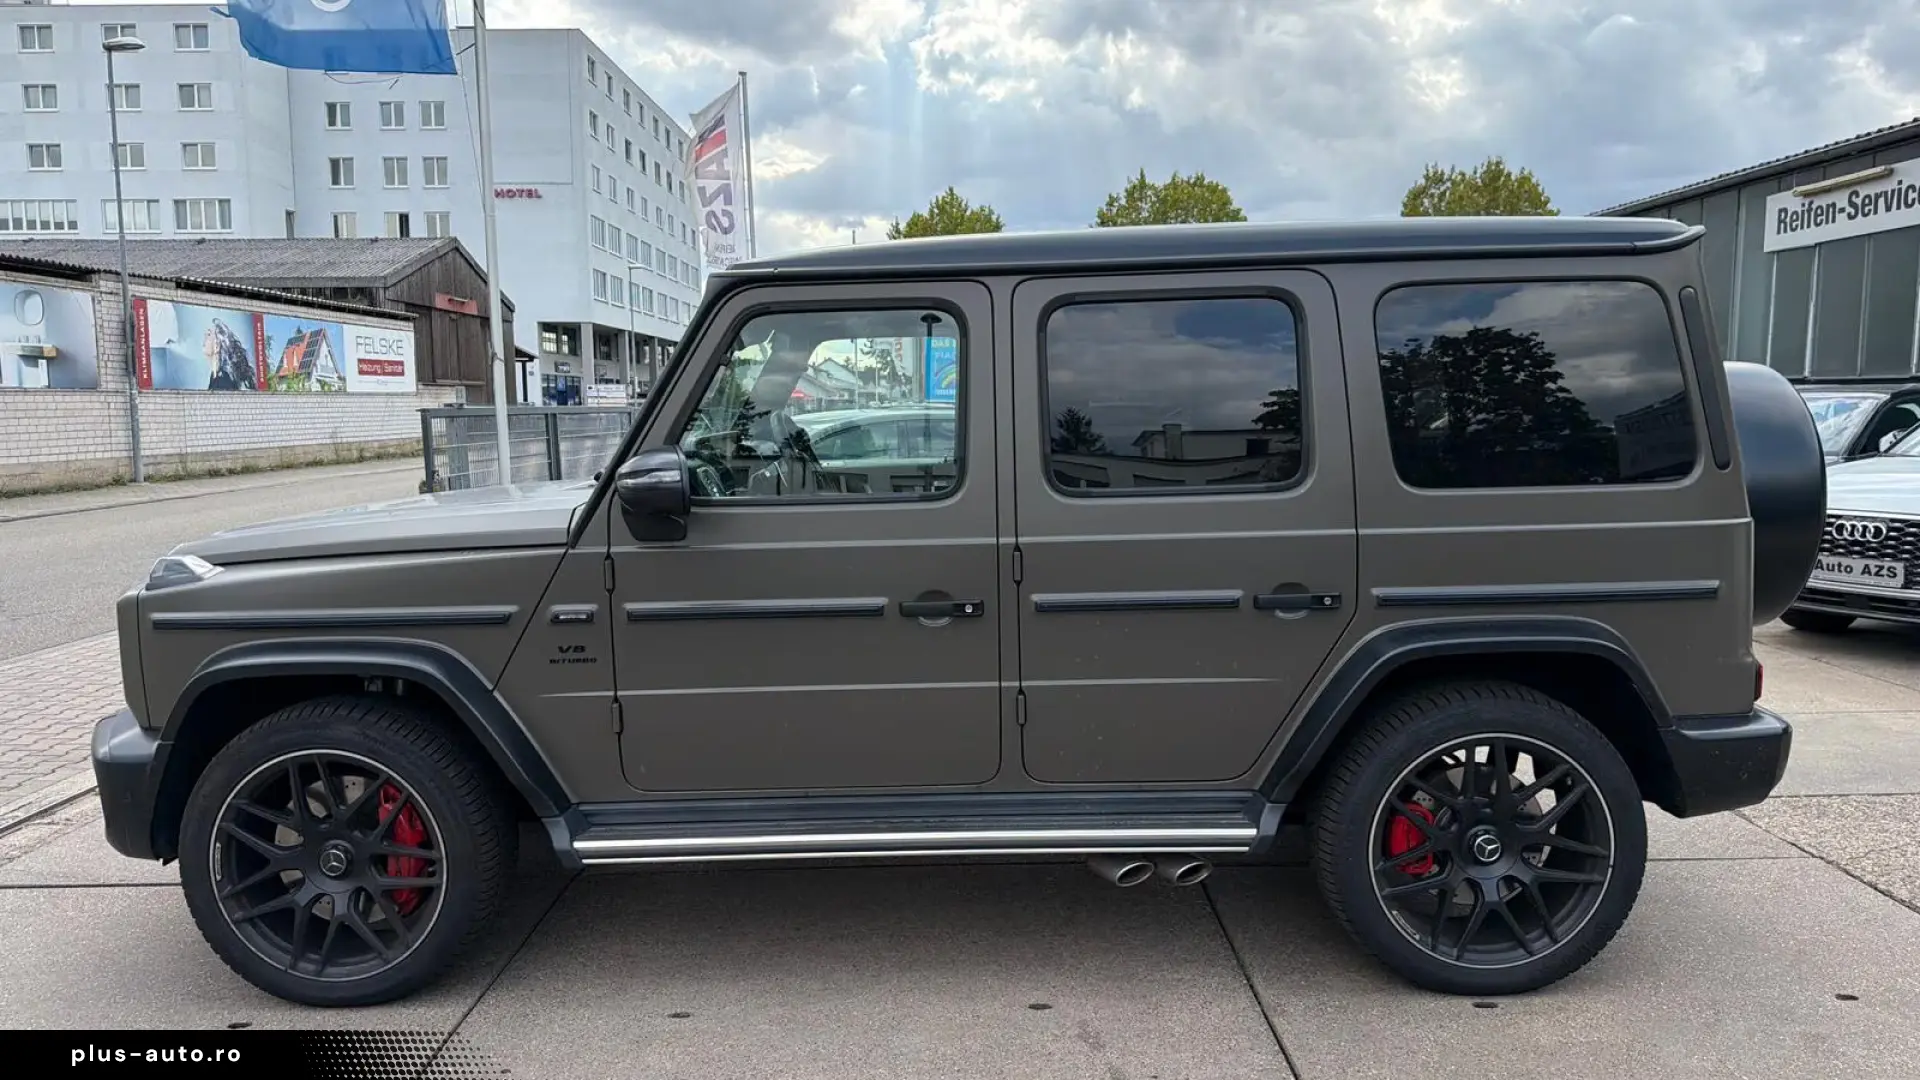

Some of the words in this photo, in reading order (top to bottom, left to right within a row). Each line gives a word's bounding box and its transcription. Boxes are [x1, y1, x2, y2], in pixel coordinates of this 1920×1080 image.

[494, 188, 542, 199] HOTEL
[1776, 180, 1920, 235] Reifen-Servic
[139, 308, 148, 379] KLIMAANLAGEN
[356, 336, 403, 356] FELSKE
[1815, 559, 1853, 574] Auto
[1861, 564, 1897, 579] AZS
[558, 645, 586, 654] V8
